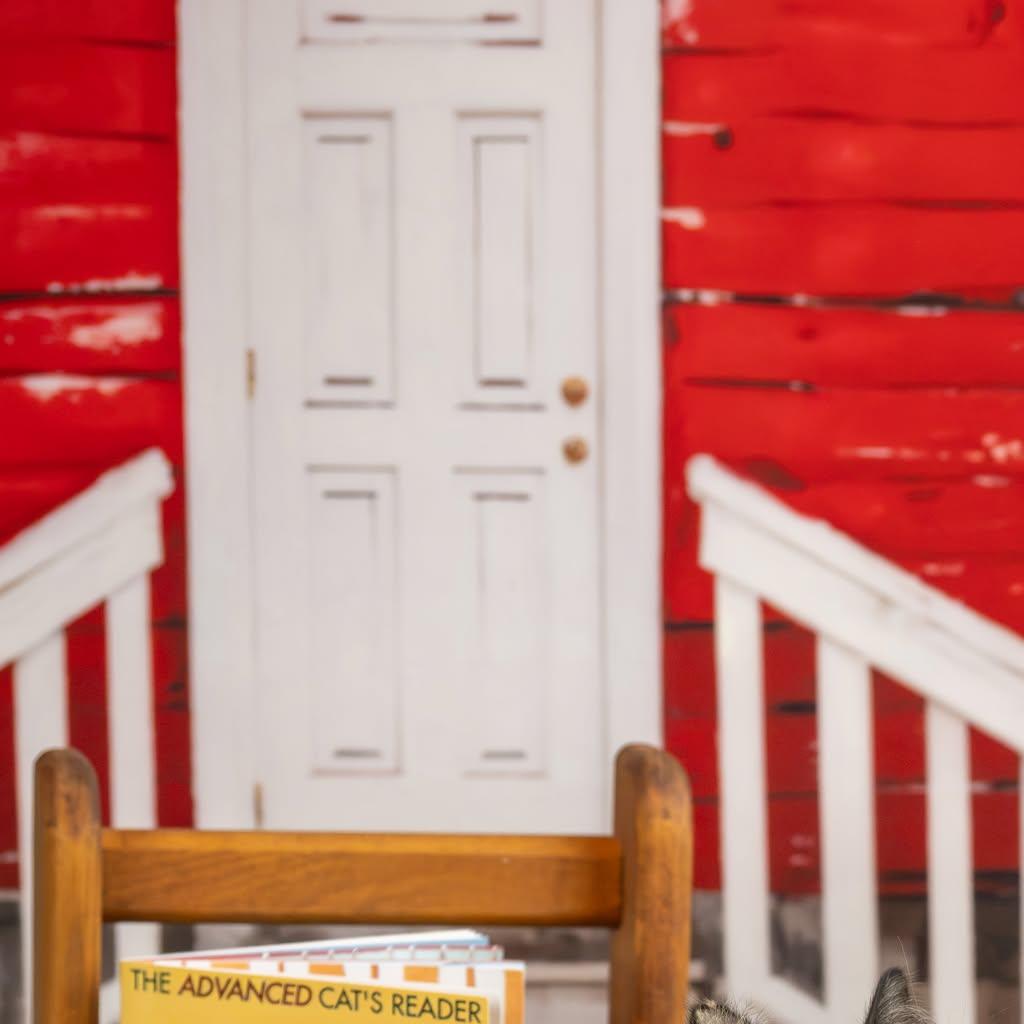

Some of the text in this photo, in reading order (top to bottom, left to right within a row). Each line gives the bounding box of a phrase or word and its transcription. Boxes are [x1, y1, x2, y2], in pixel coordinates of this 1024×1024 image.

[130, 969, 482, 1024] THE ADVANCED CAT'S READER
